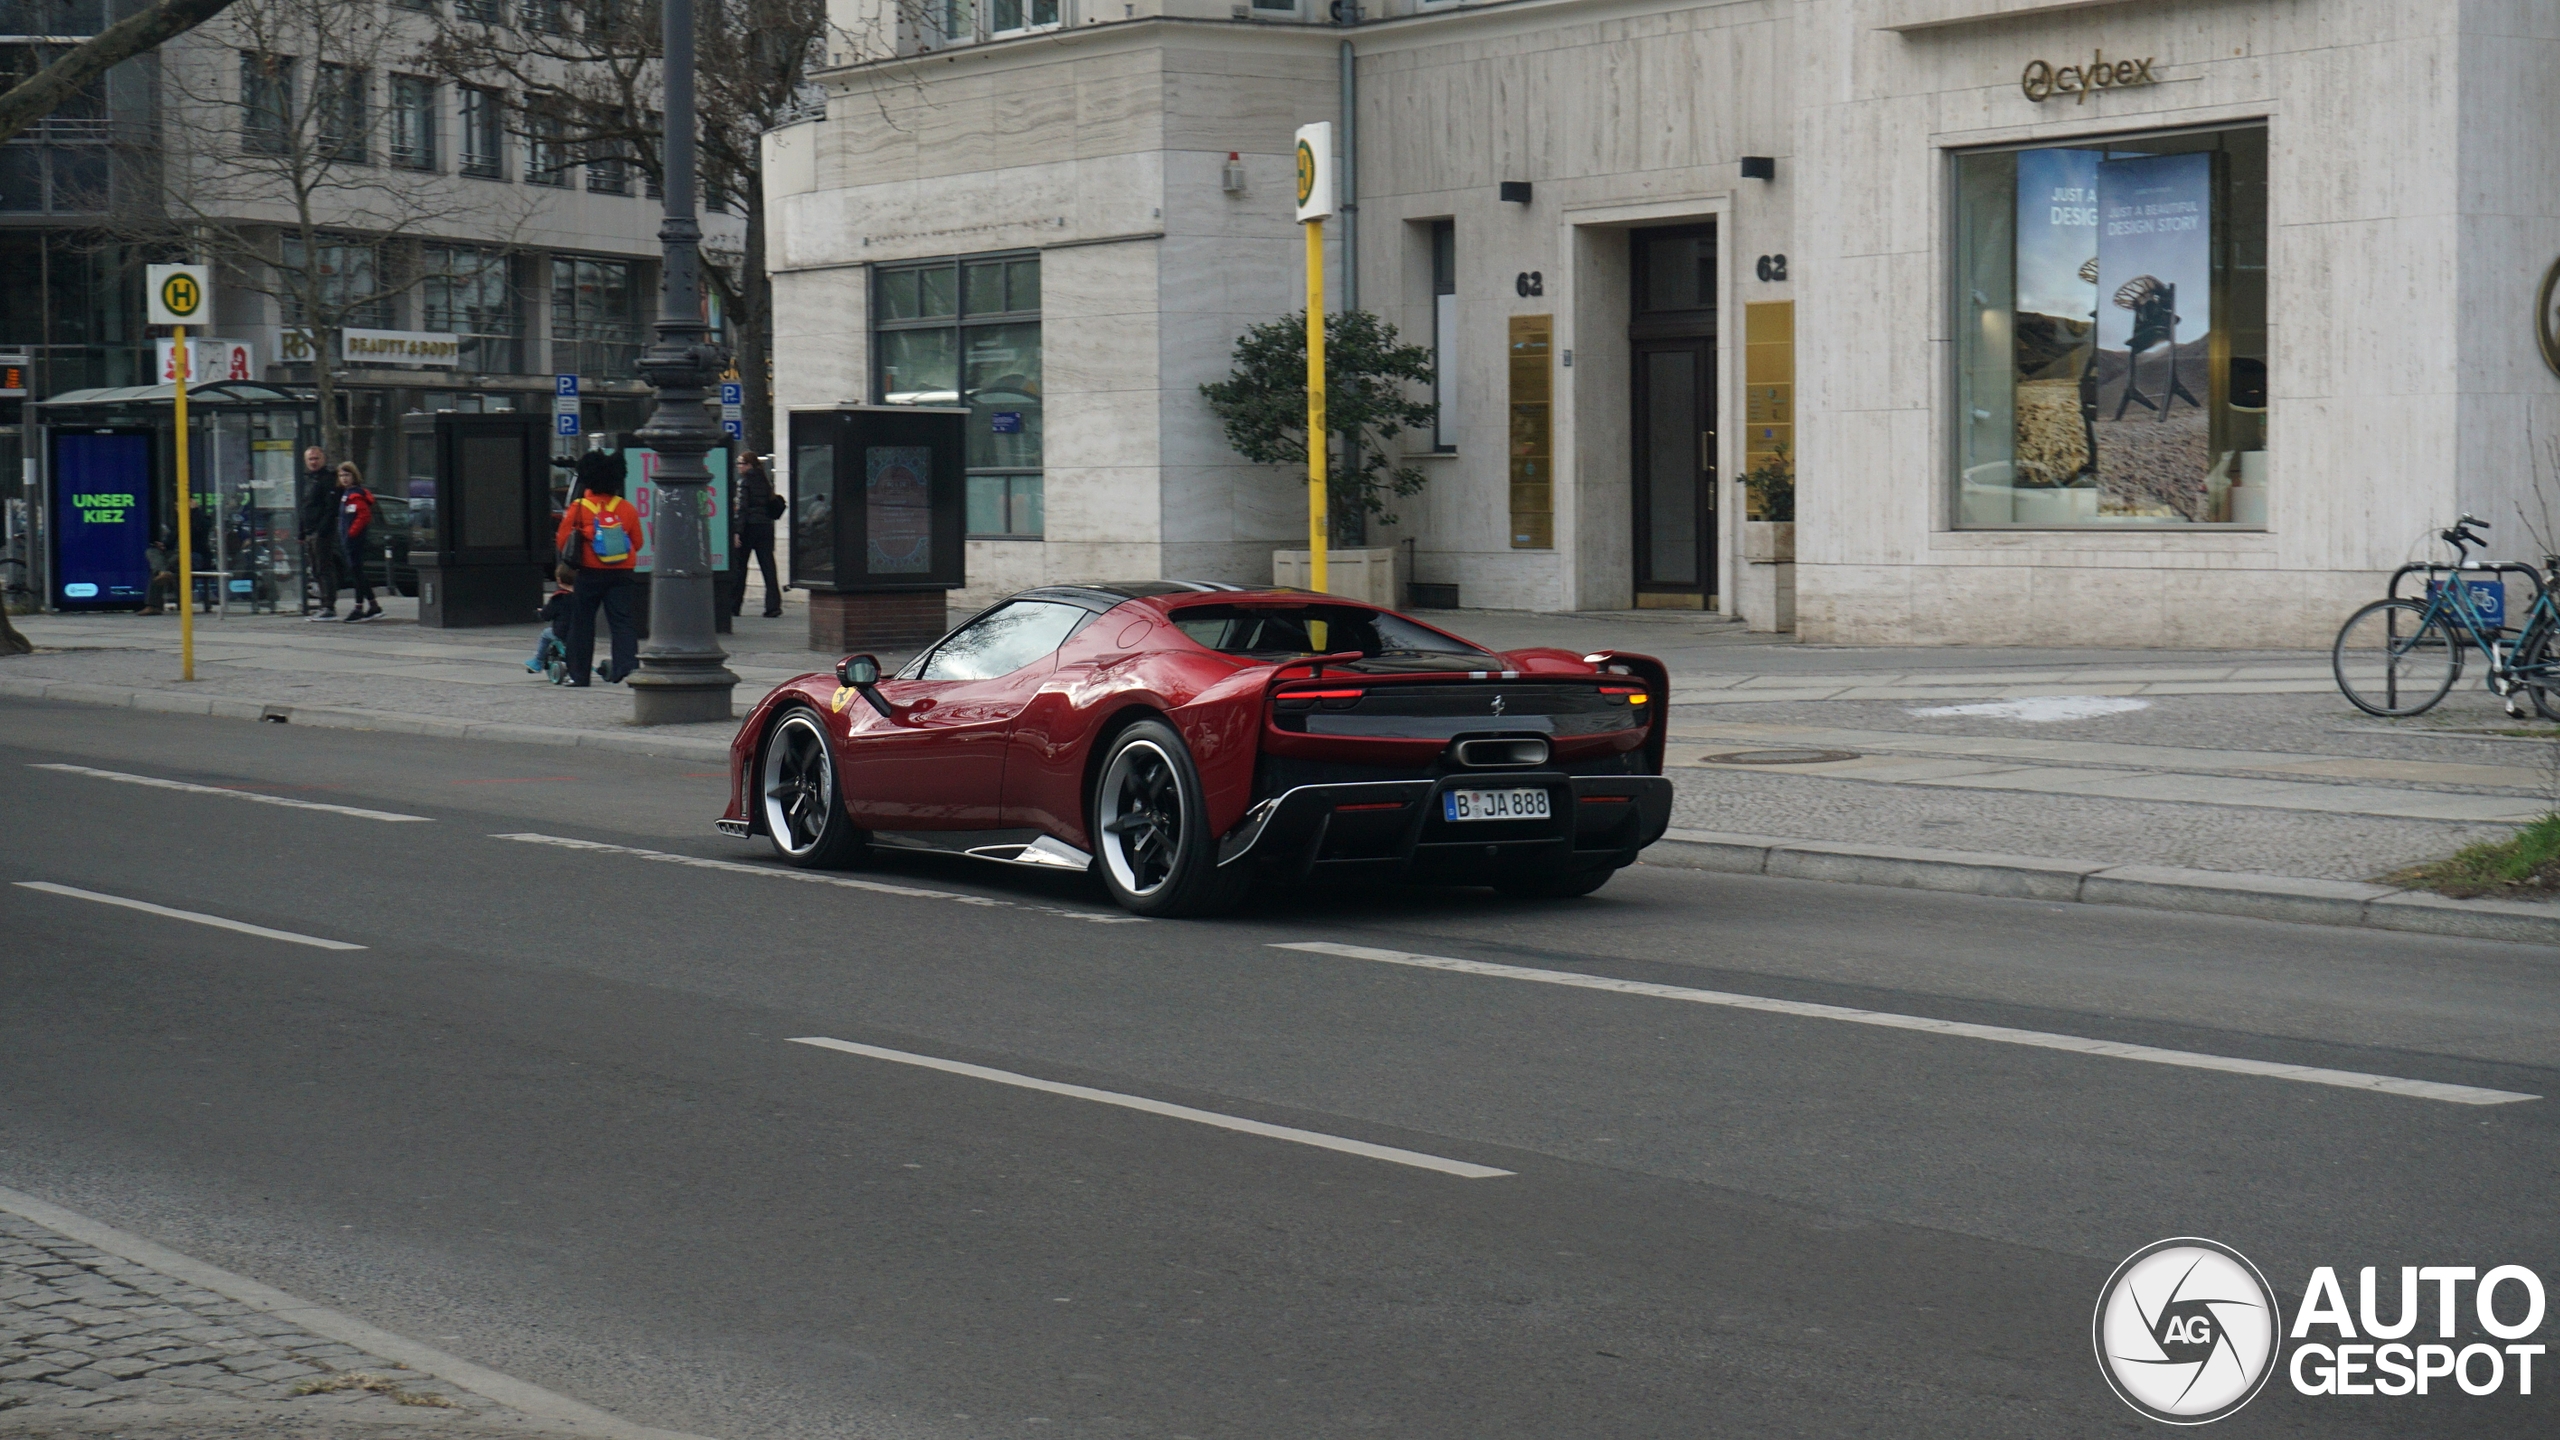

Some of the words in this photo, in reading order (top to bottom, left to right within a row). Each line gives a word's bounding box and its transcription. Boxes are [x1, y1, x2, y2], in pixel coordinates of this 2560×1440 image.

[2056, 48, 2157, 105] cybex
[2051, 187, 2084, 202] JUST
[2086, 189, 2098, 203] A
[2051, 206, 2098, 227] DESIG
[2108, 206, 2132, 219] JUST
[2134, 205, 2143, 217] A
[2145, 201, 2199, 216] BEAUTIFUL
[2107, 218, 2155, 236] DESIGN
[2157, 215, 2199, 233] STORY
[1757, 254, 1787, 282] 62
[1516, 271, 1543, 298] 62
[172, 282, 191, 307] H
[349, 337, 407, 354] BEAUTY
[559, 376, 573, 394] P
[723, 386, 736, 402] P
[561, 415, 573, 433] P
[72, 493, 135, 508] UNSER
[83, 510, 125, 523] KIEZ
[1457, 794, 1470, 817] B
[1484, 793, 1509, 816] JA
[1512, 791, 1547, 815] 888
